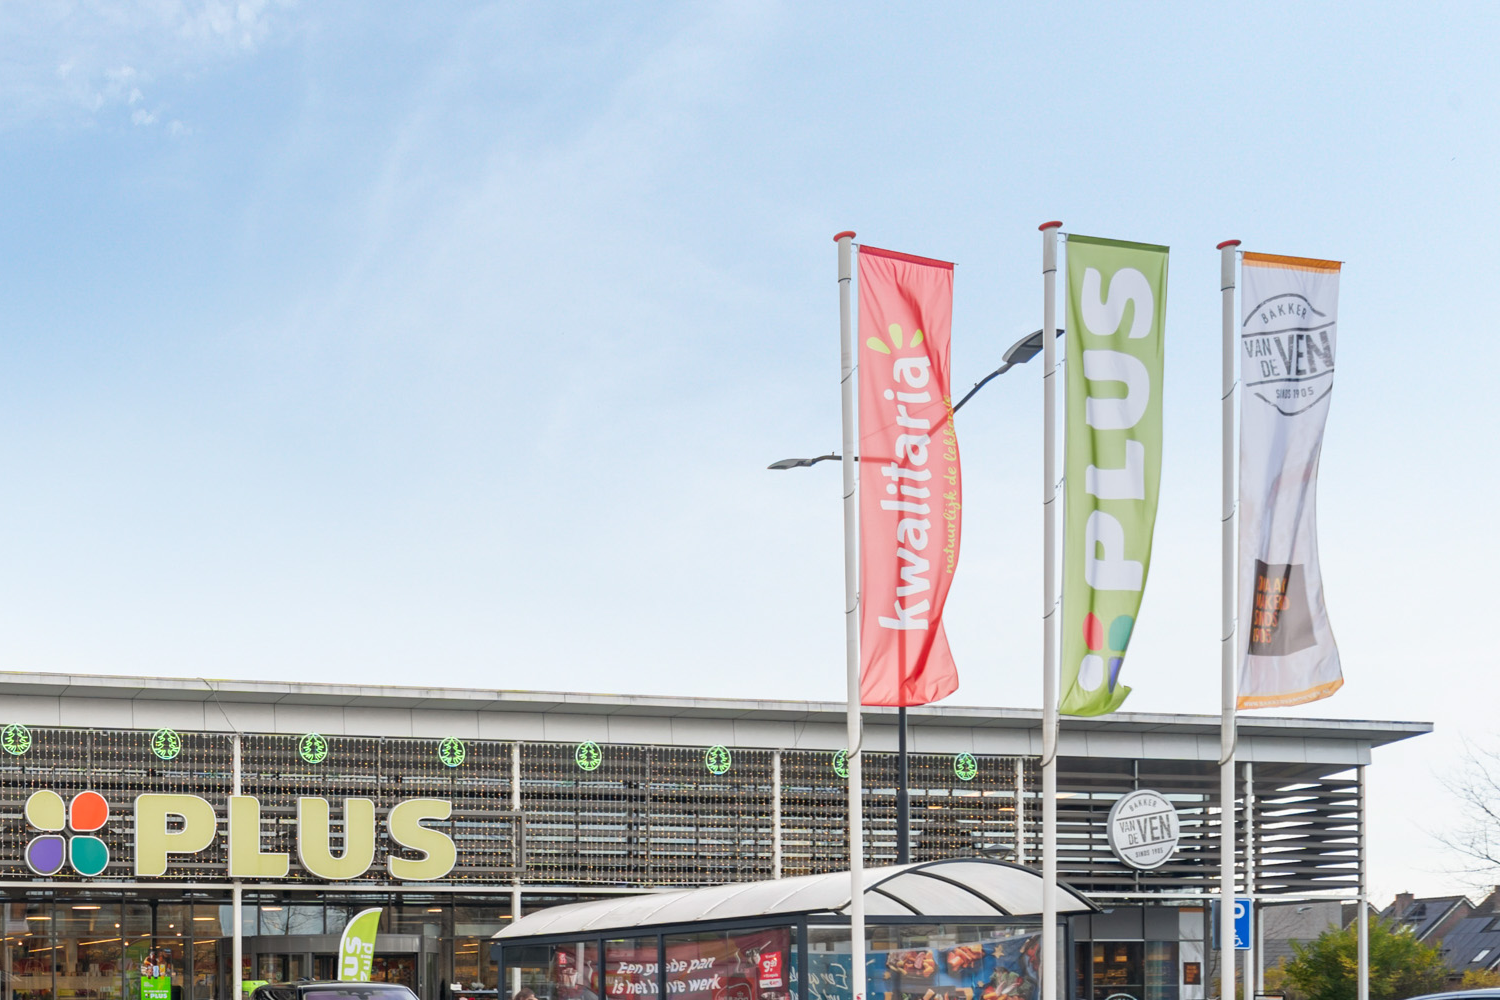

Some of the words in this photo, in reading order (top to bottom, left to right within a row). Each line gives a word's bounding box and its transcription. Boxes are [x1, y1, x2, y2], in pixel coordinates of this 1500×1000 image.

[1261, 303, 1306, 324] BAKKER
[1244, 338, 1272, 358] VAN
[1273, 330, 1334, 376] VEN
[1260, 359, 1280, 377] DE
[1293, 386, 1314, 398] 1905
[1081, 267, 1154, 591] PLUS
[943, 466, 957, 485] de
[878, 356, 931, 630] kwalitaria
[943, 489, 961, 573] natuurlijk
[1128, 799, 1157, 811] BAKKER
[134, 793, 457, 880] PLUS
[1119, 820, 1135, 833] VAN
[1136, 814, 1172, 843] VEN
[1128, 833, 1139, 845] DE
[1135, 850, 1150, 858] SINDS
[344, 936, 361, 981] US
[617, 962, 643, 974] Een
[687, 957, 716, 973] pan
[612, 980, 624, 994] is
[626, 979, 648, 994] het
[688, 974, 721, 992] werk
